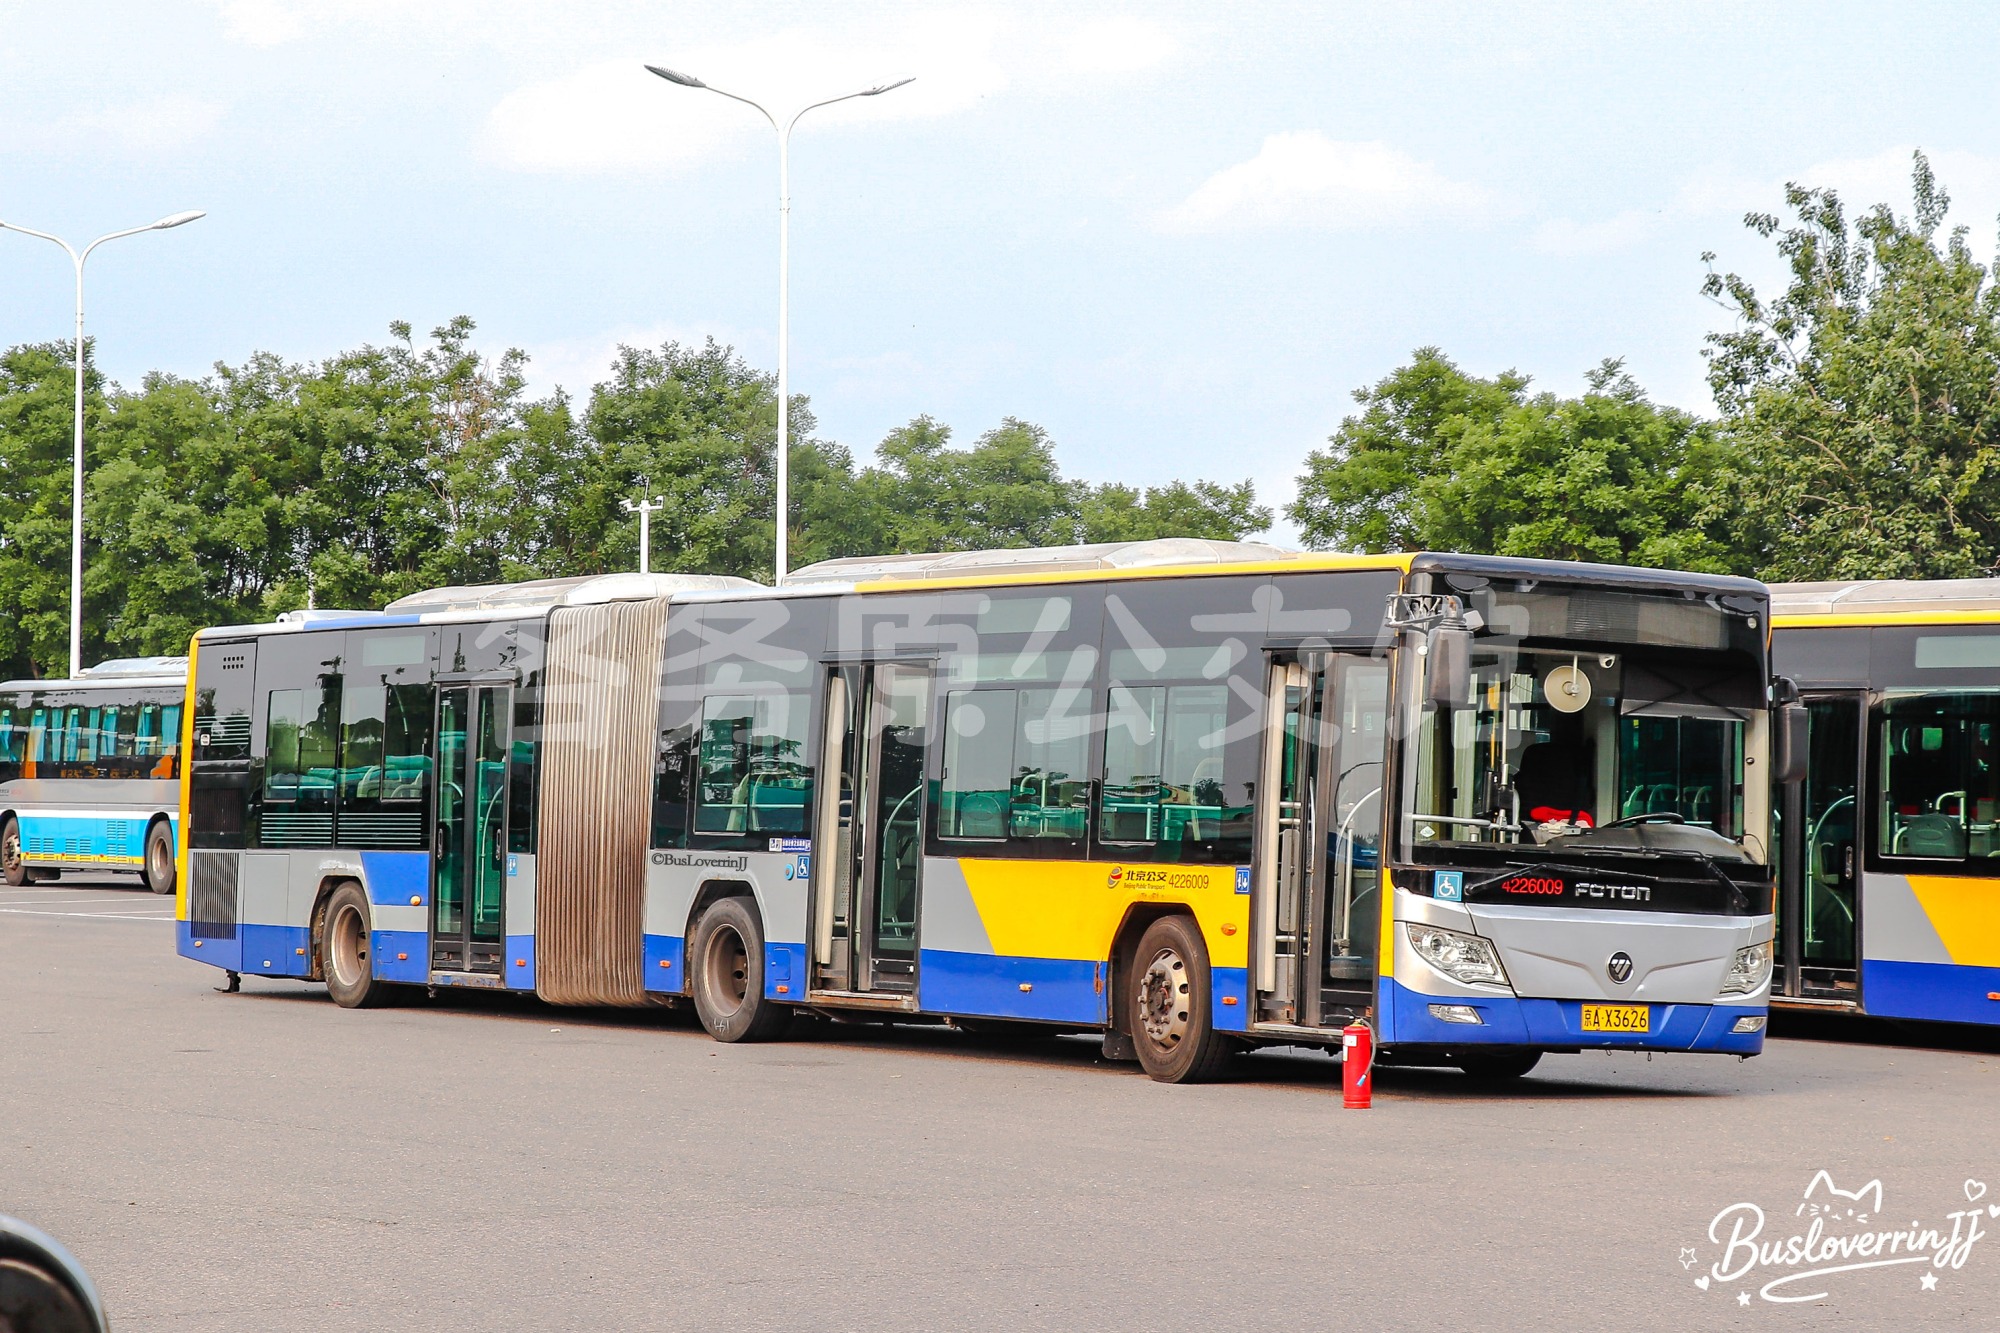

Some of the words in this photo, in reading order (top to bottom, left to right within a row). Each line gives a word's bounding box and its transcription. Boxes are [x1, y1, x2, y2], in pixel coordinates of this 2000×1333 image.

[1125, 870, 1167, 881] 北京公交
[1169, 874, 1209, 889] 4226009
[1502, 878, 1563, 895] 4226009
[1575, 883, 1651, 901] FOTON
